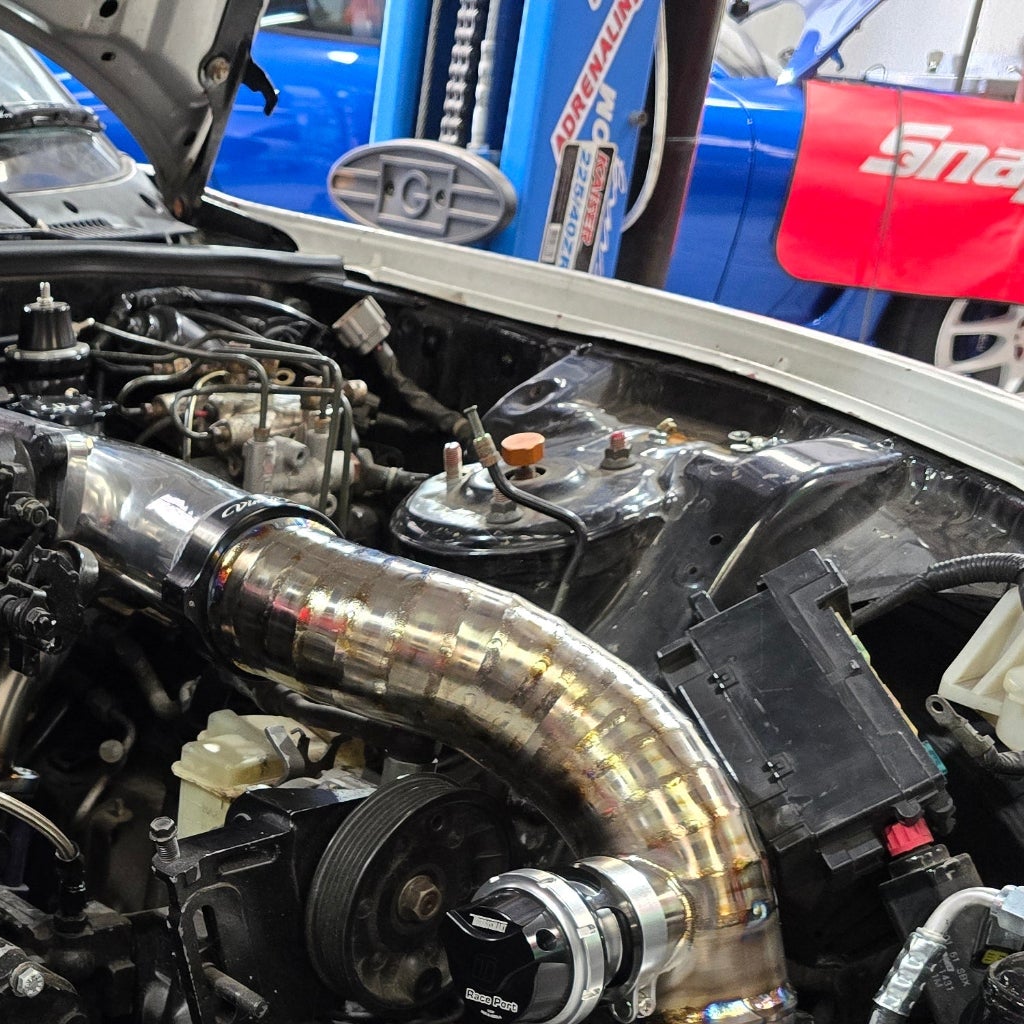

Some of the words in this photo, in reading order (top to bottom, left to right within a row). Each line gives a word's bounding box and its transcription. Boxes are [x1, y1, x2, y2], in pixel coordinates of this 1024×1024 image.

[555, 0, 639, 150] ADRENALIN
[859, 121, 1024, 204] Sna
[465, 988, 492, 1005] Race
